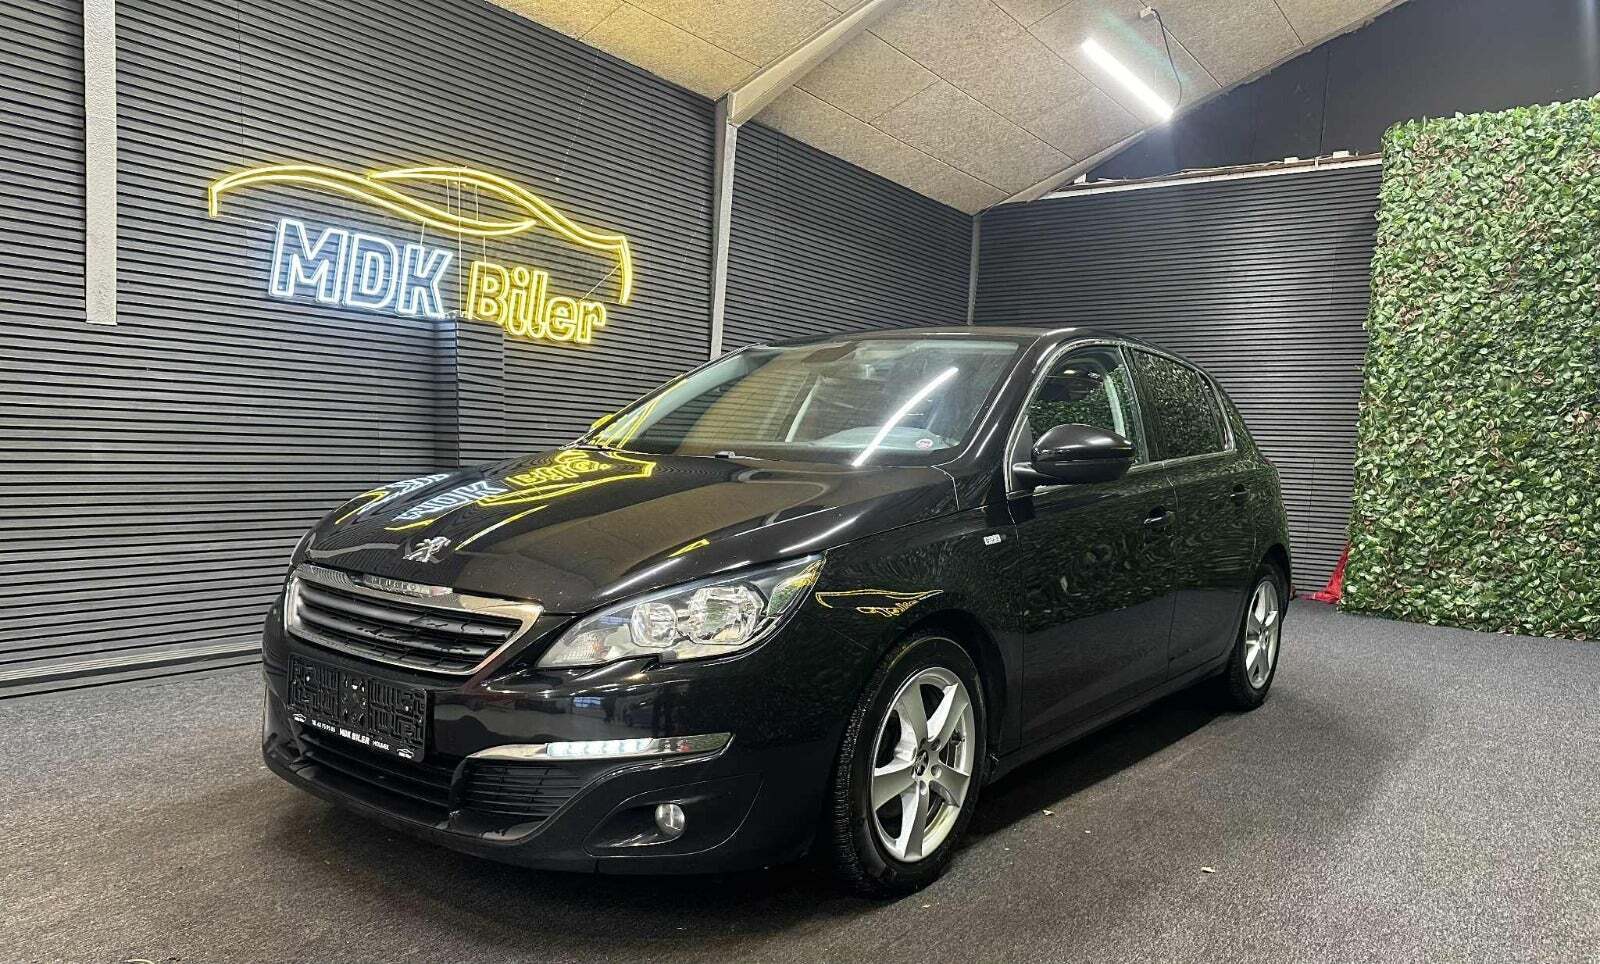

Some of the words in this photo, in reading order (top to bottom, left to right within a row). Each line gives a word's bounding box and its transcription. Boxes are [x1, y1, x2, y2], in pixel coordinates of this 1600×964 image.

[270, 219, 453, 319] MDK
[467, 261, 606, 344] Biler
[351, 732, 370, 745] BILER
